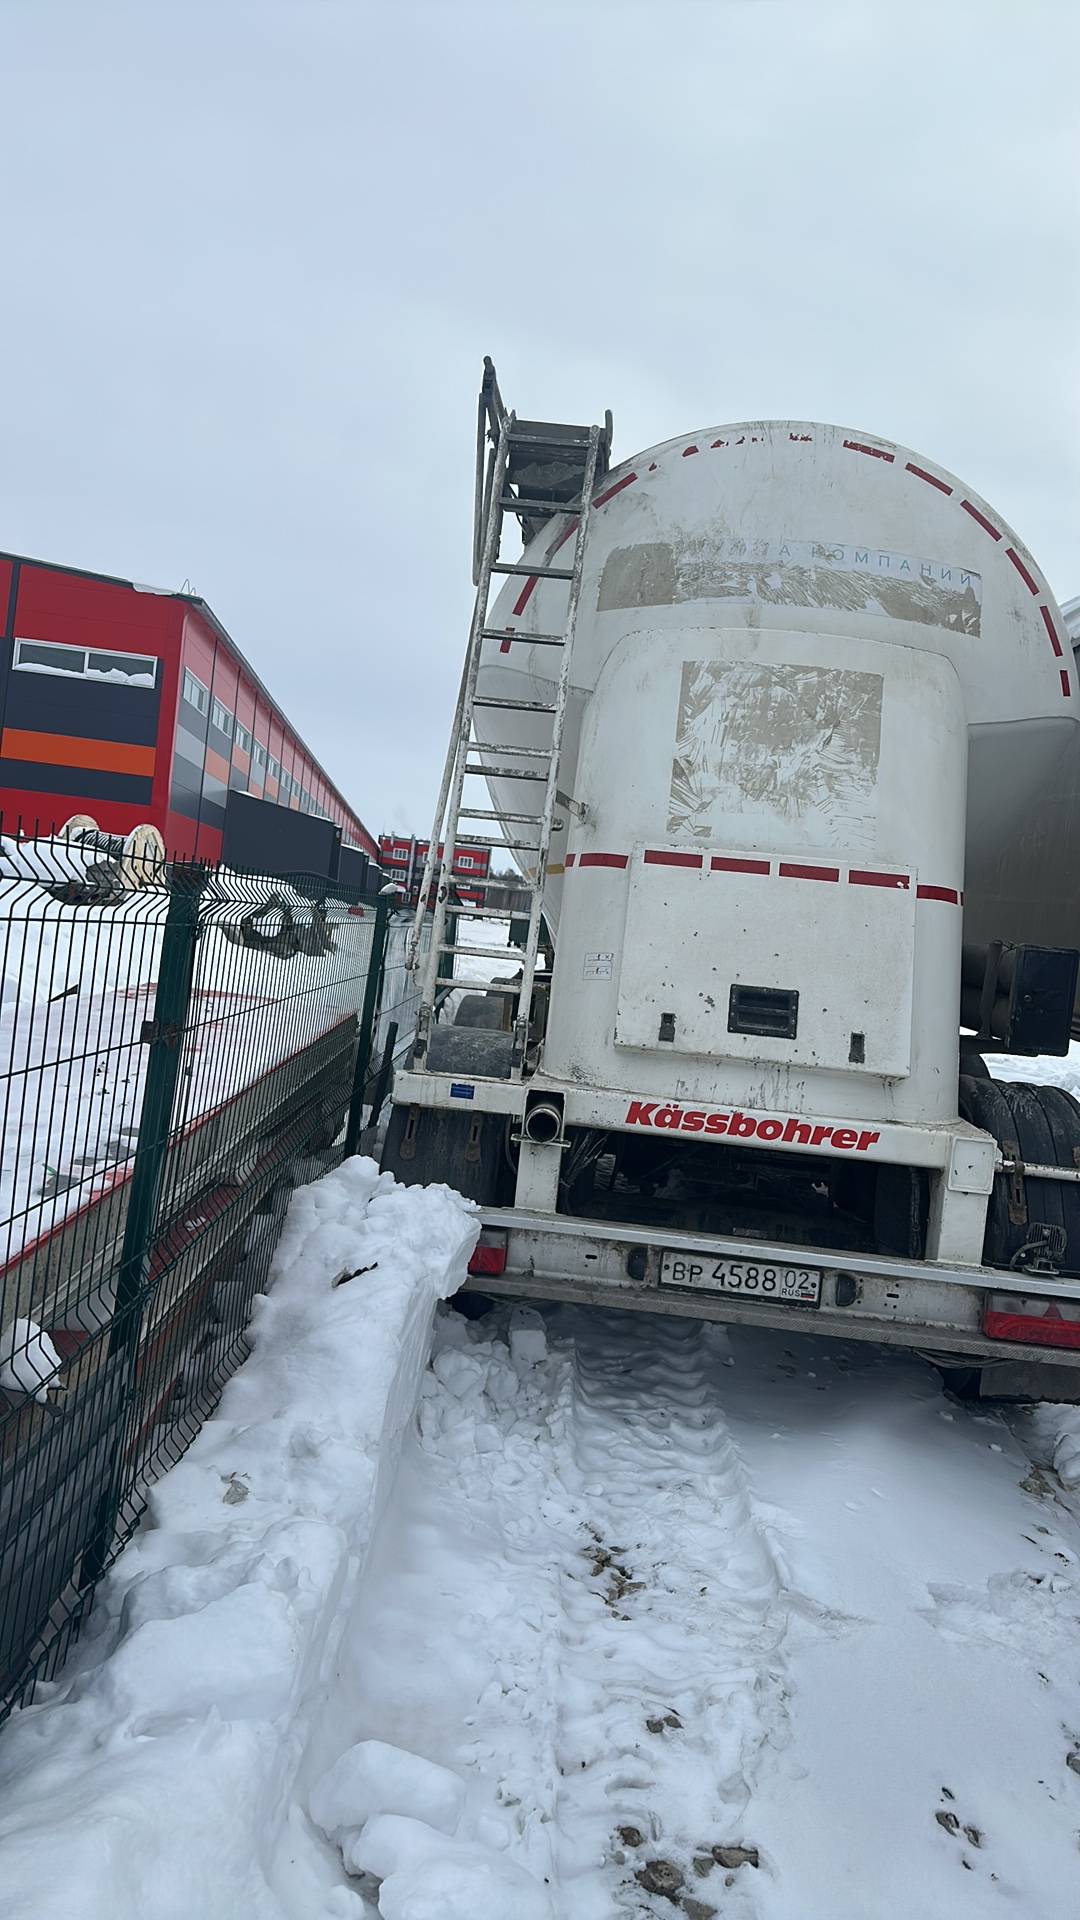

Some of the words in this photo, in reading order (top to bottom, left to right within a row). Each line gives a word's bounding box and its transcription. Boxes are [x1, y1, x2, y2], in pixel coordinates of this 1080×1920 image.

[625, 1101, 880, 1150] Kässbohrer
[712, 1262, 776, 1292] 4588
[785, 1270, 809, 1290] 02
[780, 1287, 801, 1298] RUS
